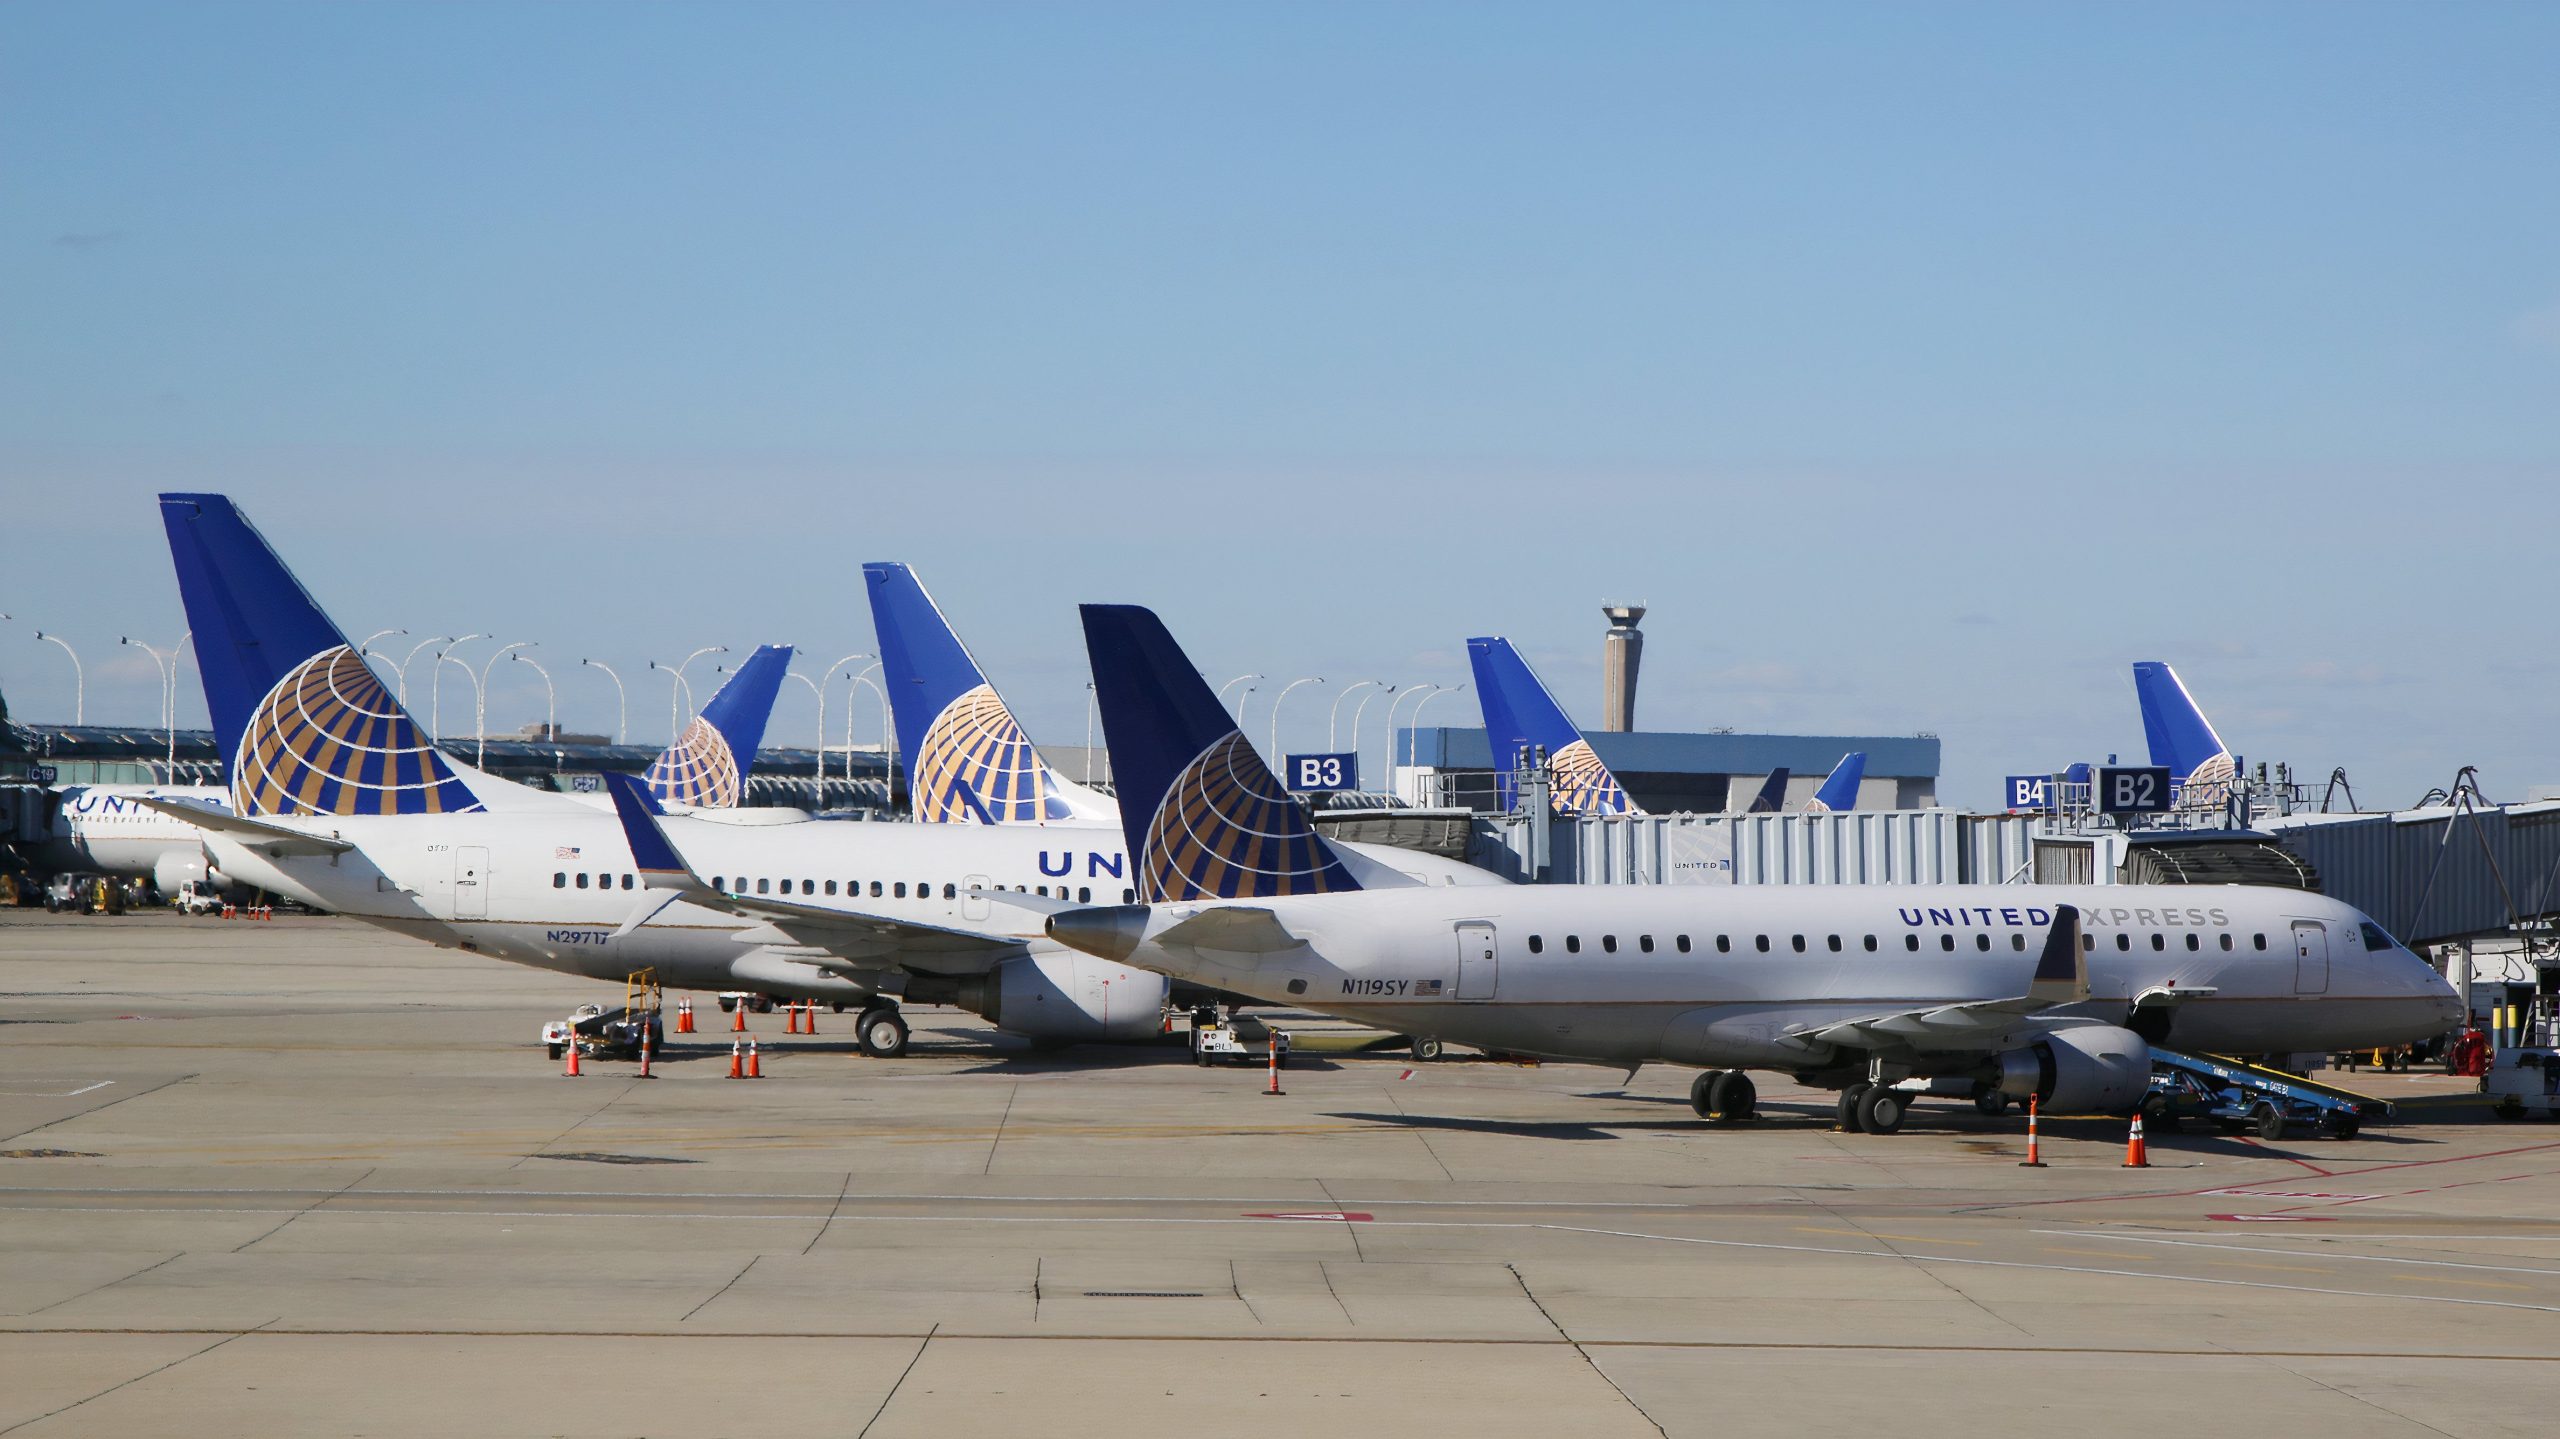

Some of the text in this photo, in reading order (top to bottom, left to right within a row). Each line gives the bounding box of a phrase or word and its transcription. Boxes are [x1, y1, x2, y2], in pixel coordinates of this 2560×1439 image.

[1300, 758, 1342, 787] B3
[2015, 779, 2044, 805] B4
[2115, 774, 2155, 807] B2
[1898, 907, 2230, 926] UNITED XPRESS
[547, 930, 609, 944] N29717
[1342, 979, 1408, 995] N119SY
